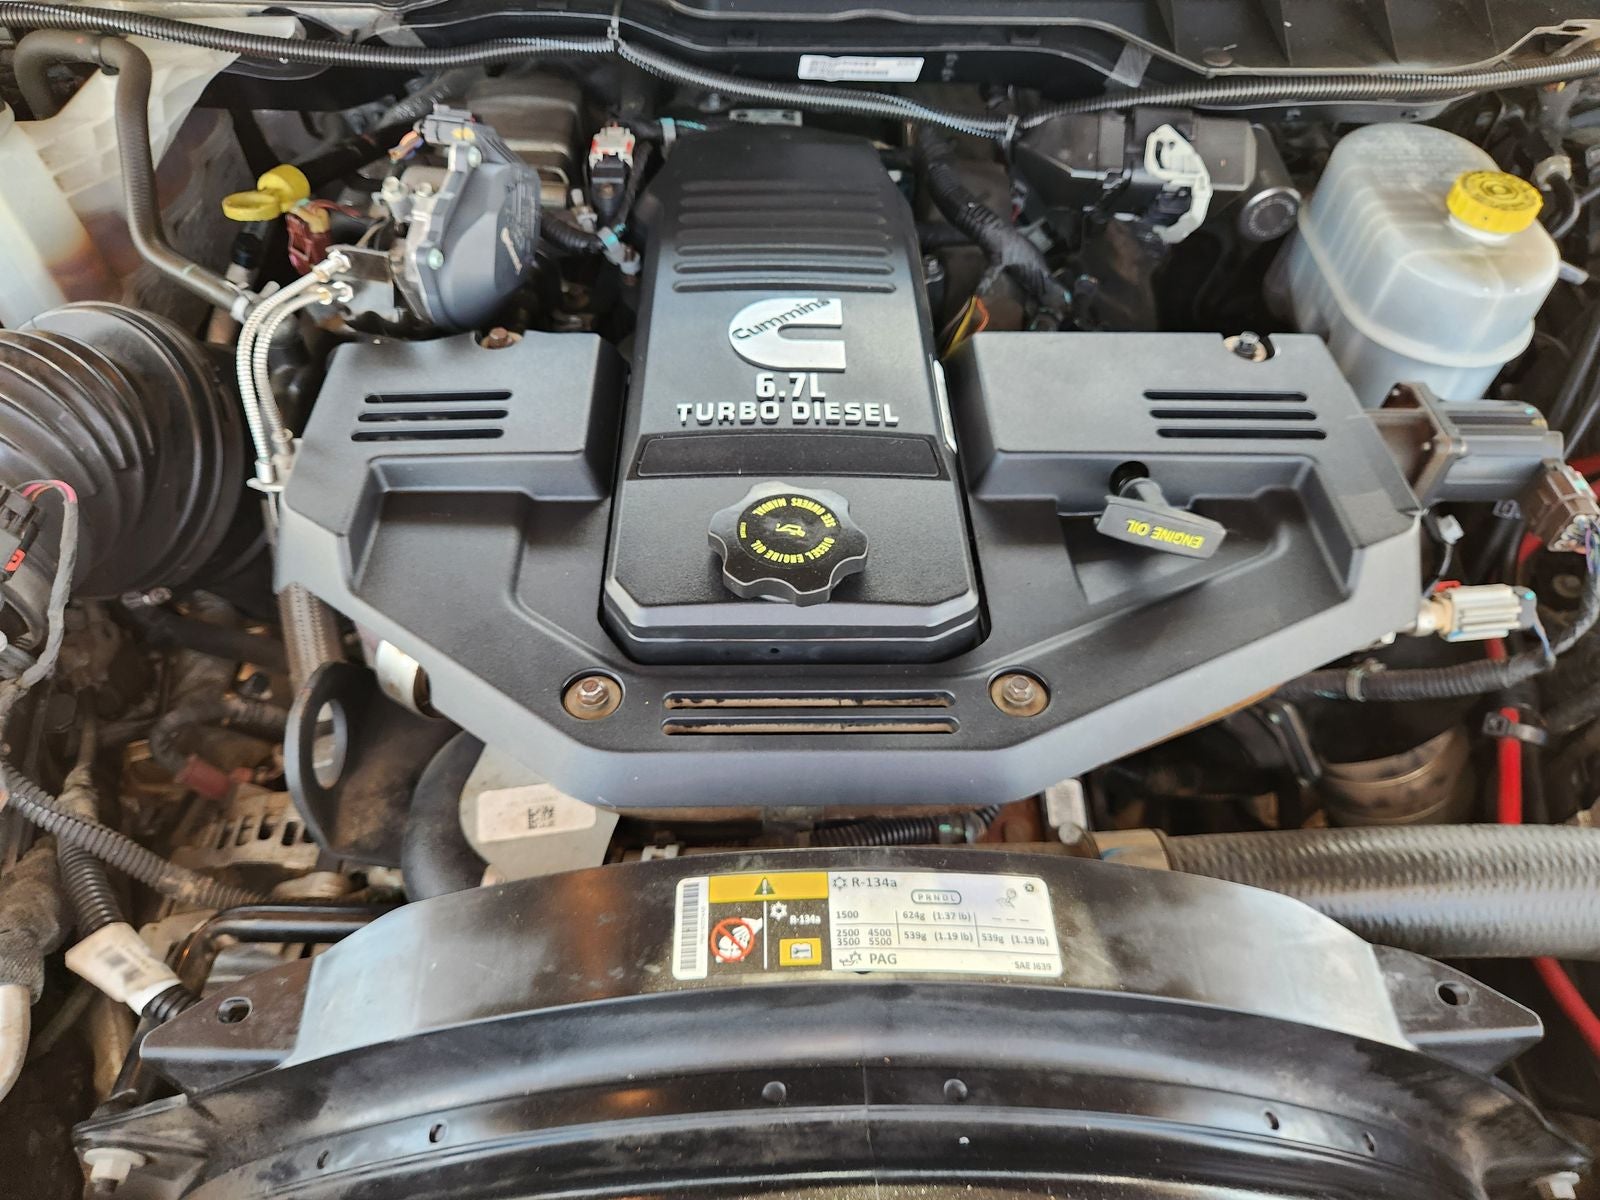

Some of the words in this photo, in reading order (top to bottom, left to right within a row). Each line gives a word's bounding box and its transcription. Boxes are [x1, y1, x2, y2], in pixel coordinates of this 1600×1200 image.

[732, 298, 831, 340] Cummins
[755, 371, 826, 401] 6.7L
[676, 401, 780, 426] TURBO
[791, 401, 900, 427] DIESEL
[1126, 519, 1150, 536] OIL
[1151, 526, 1205, 548] ENGINE
[750, 539, 767, 554] OIL
[805, 536, 836, 560] DIESEL
[764, 549, 805, 564] ENGINE
[851, 877, 897, 888] R-134a
[789, 914, 821, 925] R-134a
[836, 910, 859, 919] 1500
[902, 911, 925, 921] 624g
[932, 911, 956, 921] (1.37
[958, 912, 971, 922] lb)
[836, 928, 860, 937] 2500
[867, 928, 892, 937] 4500
[903, 931, 927, 942] 539g
[934, 932, 958, 942] (1.19
[960, 932, 974, 943] lb)
[836, 938, 861, 947] 3500
[868, 938, 892, 947] 5500
[981, 933, 1004, 945] 539g
[1010, 934, 1035, 945] (1.19
[869, 953, 898, 965] PAG
[1014, 961, 1031, 970] SAE
